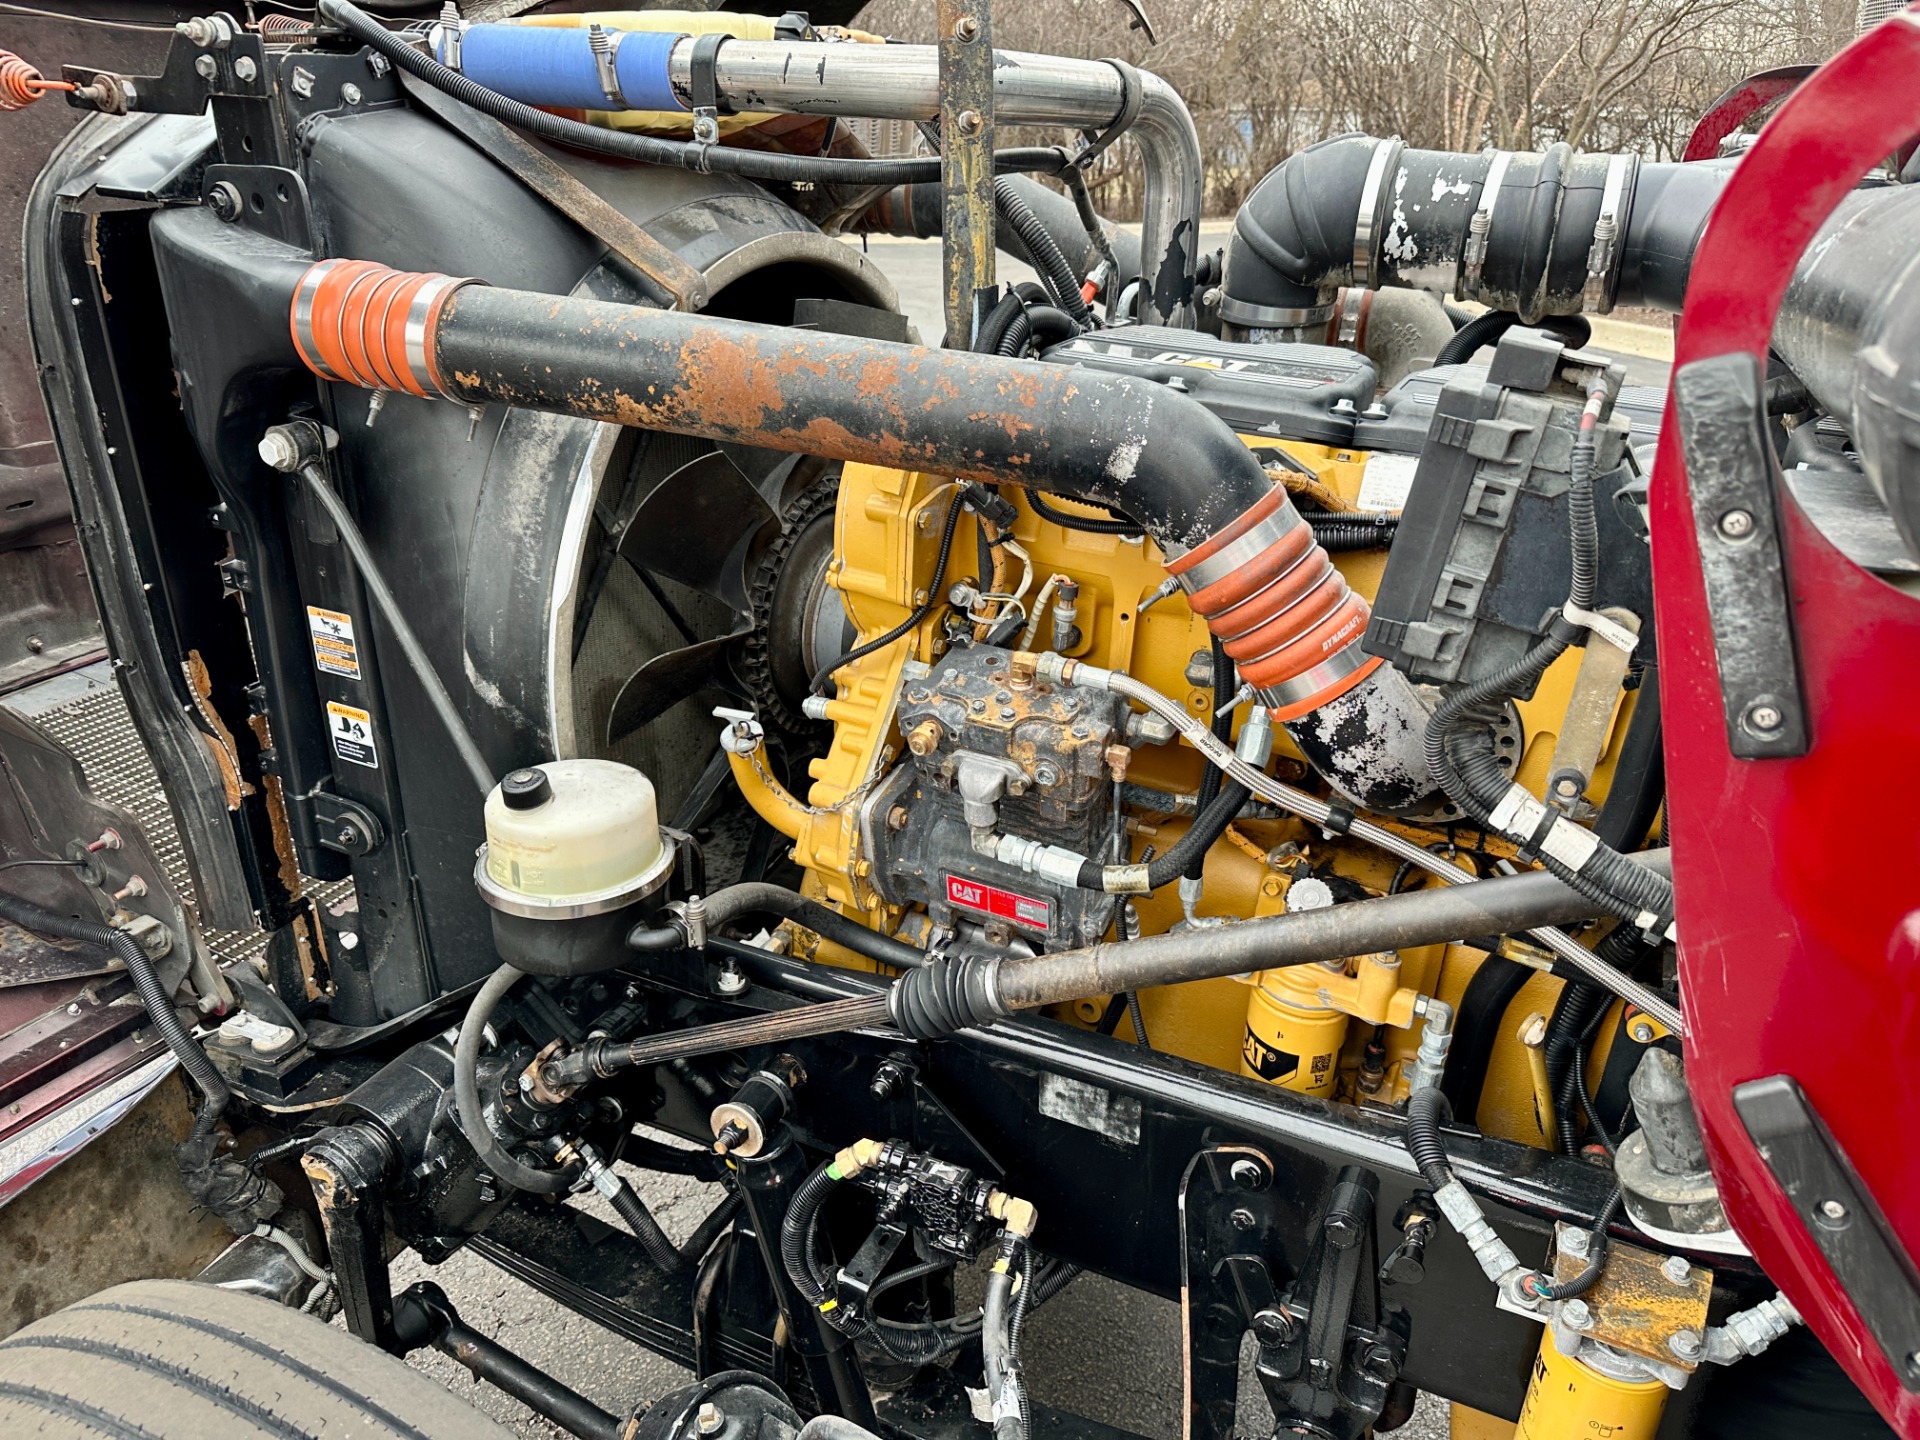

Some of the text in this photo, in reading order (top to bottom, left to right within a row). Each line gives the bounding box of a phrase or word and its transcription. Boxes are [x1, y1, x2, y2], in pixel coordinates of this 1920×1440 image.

[1150, 352, 1260, 372] CAT
[336, 707, 365, 720] WARNING
[1200, 738, 1222, 758] PACCAR
[951, 882, 983, 904] CAT
